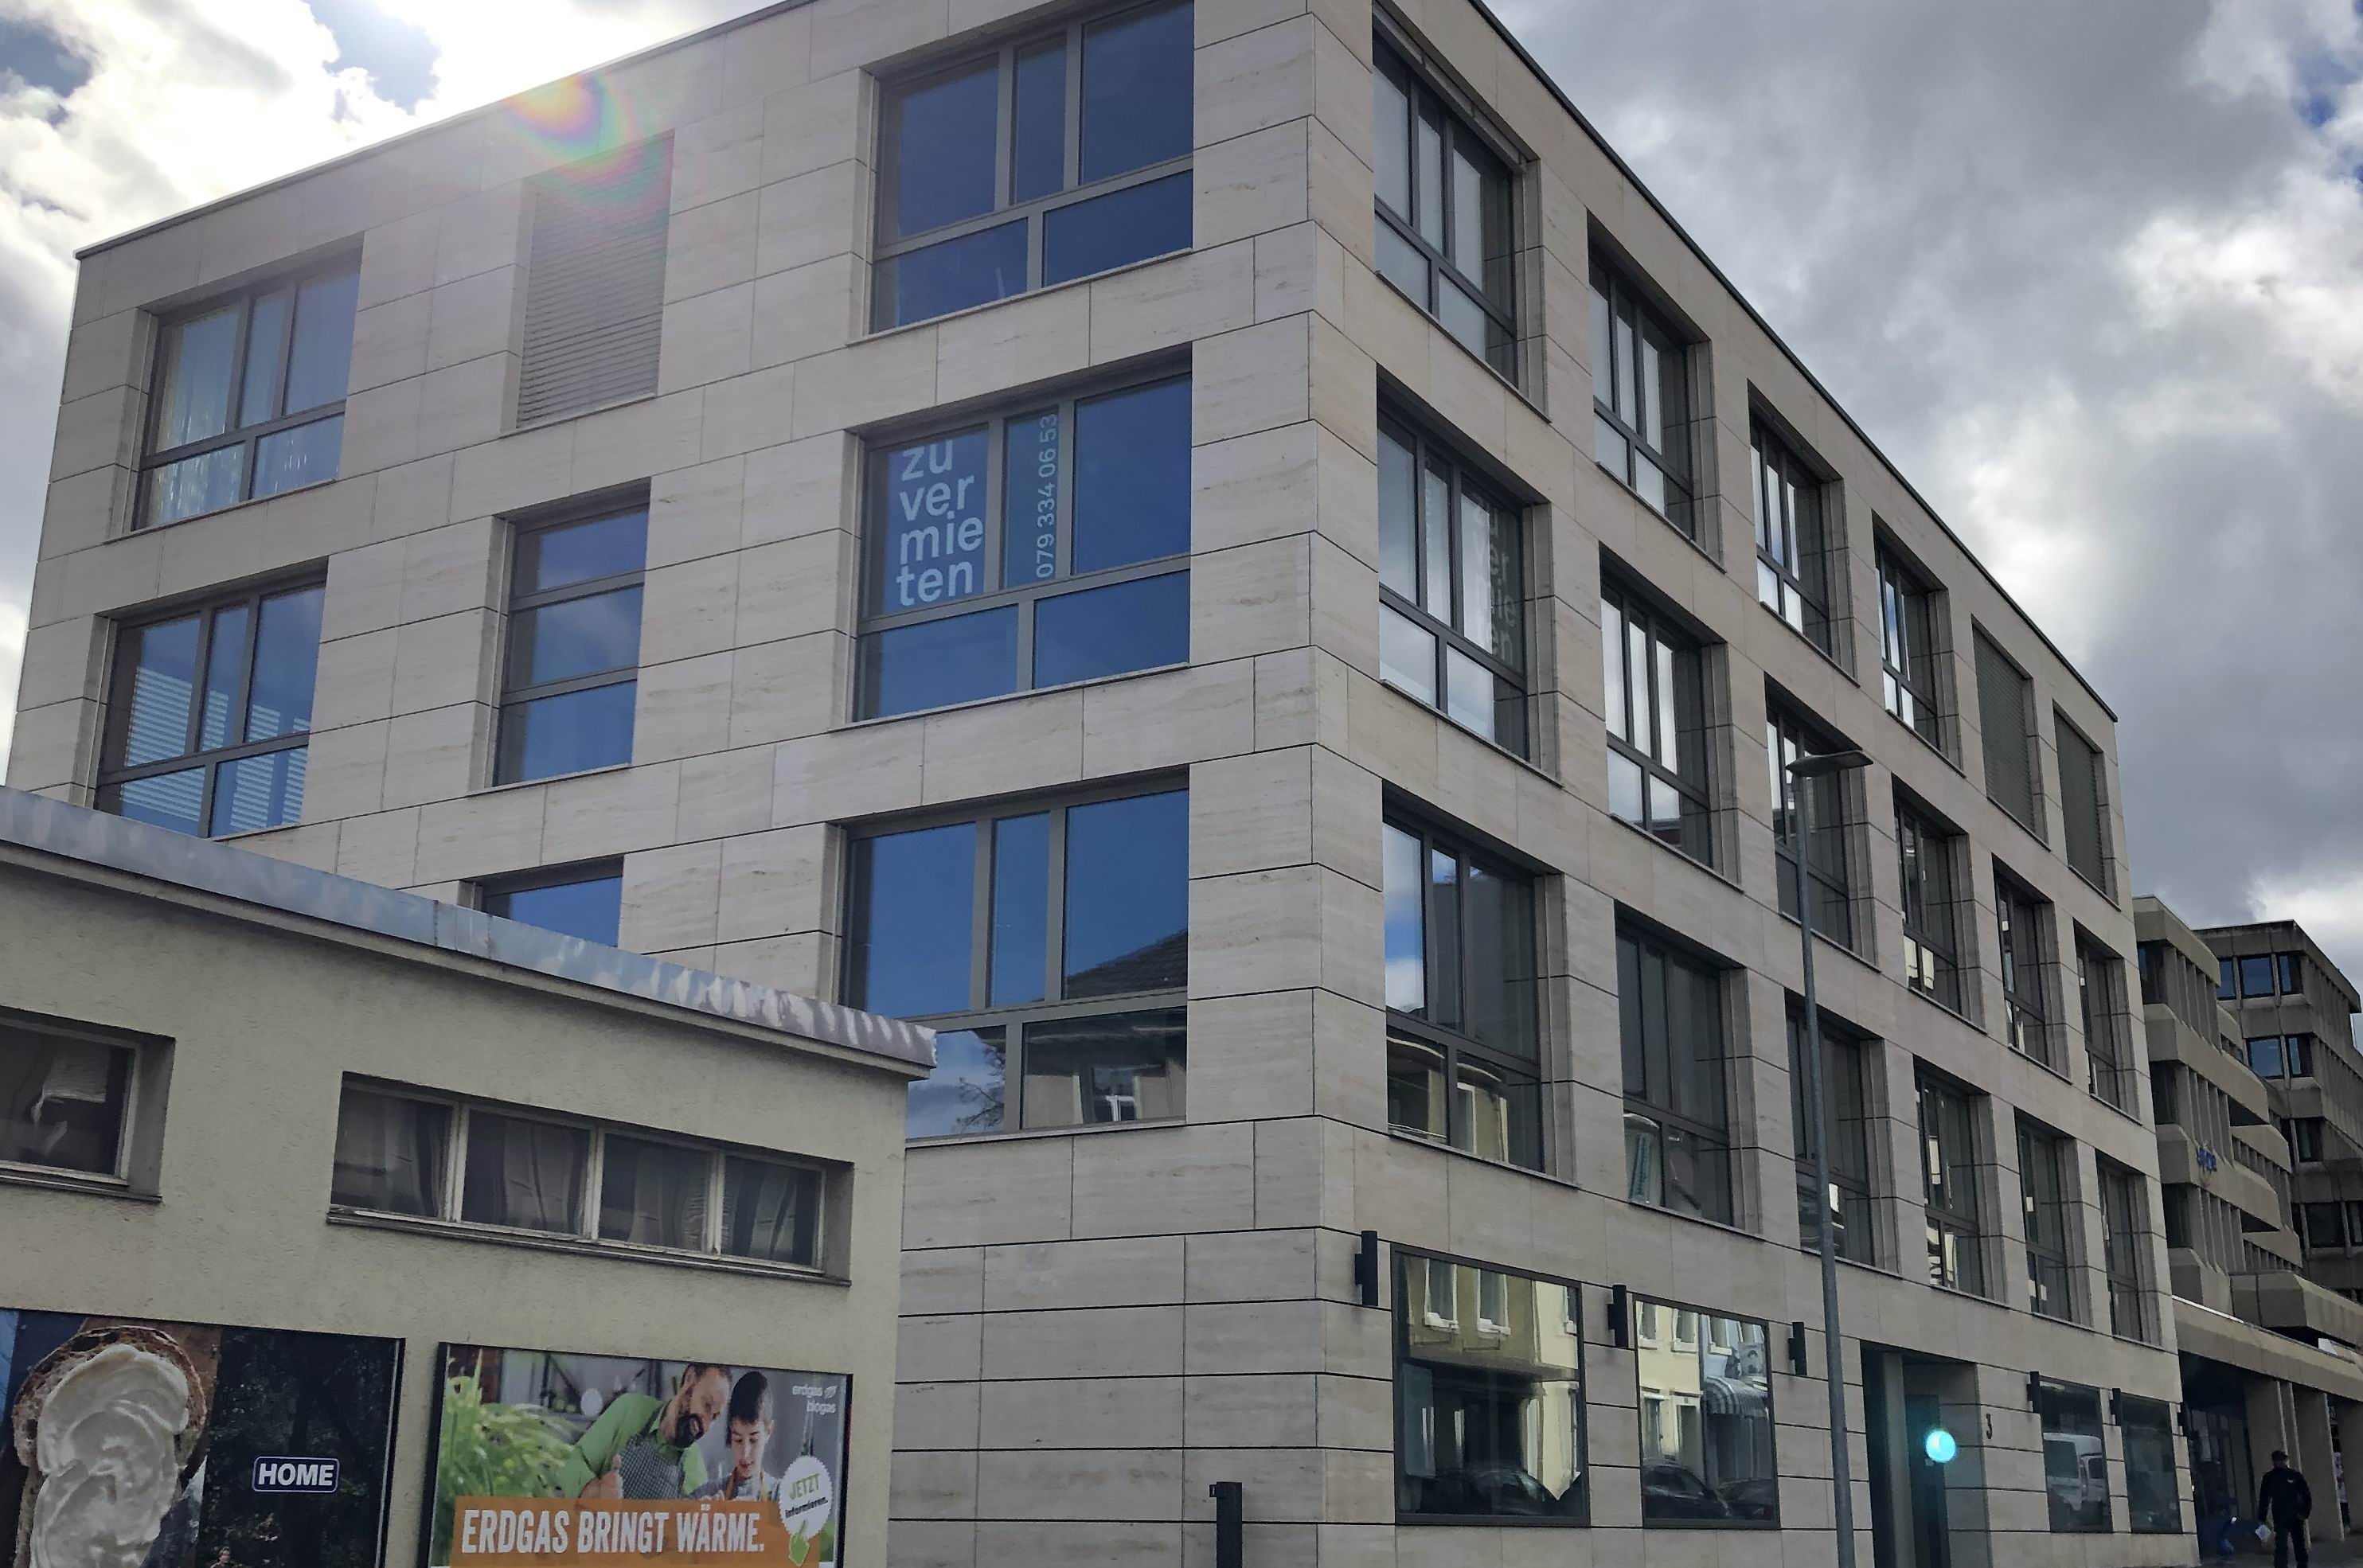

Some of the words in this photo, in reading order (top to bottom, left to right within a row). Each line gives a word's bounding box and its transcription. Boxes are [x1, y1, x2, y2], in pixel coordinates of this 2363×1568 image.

[1039, 413, 1057, 443] 53
[900, 439, 955, 482] zu
[1038, 448, 1057, 478] 06
[899, 474, 975, 521] ver
[1037, 482, 1056, 528] 334
[900, 510, 984, 565] mie
[1035, 533, 1054, 579] 079
[896, 561, 974, 607] ten
[258, 1463, 334, 1486] HOME
[788, 1473, 820, 1500] JETZT
[461, 1509, 570, 1554] ERDGAS
[577, 1510, 670, 1554] BRINGT
[677, 1502, 766, 1553] WÄRME.
